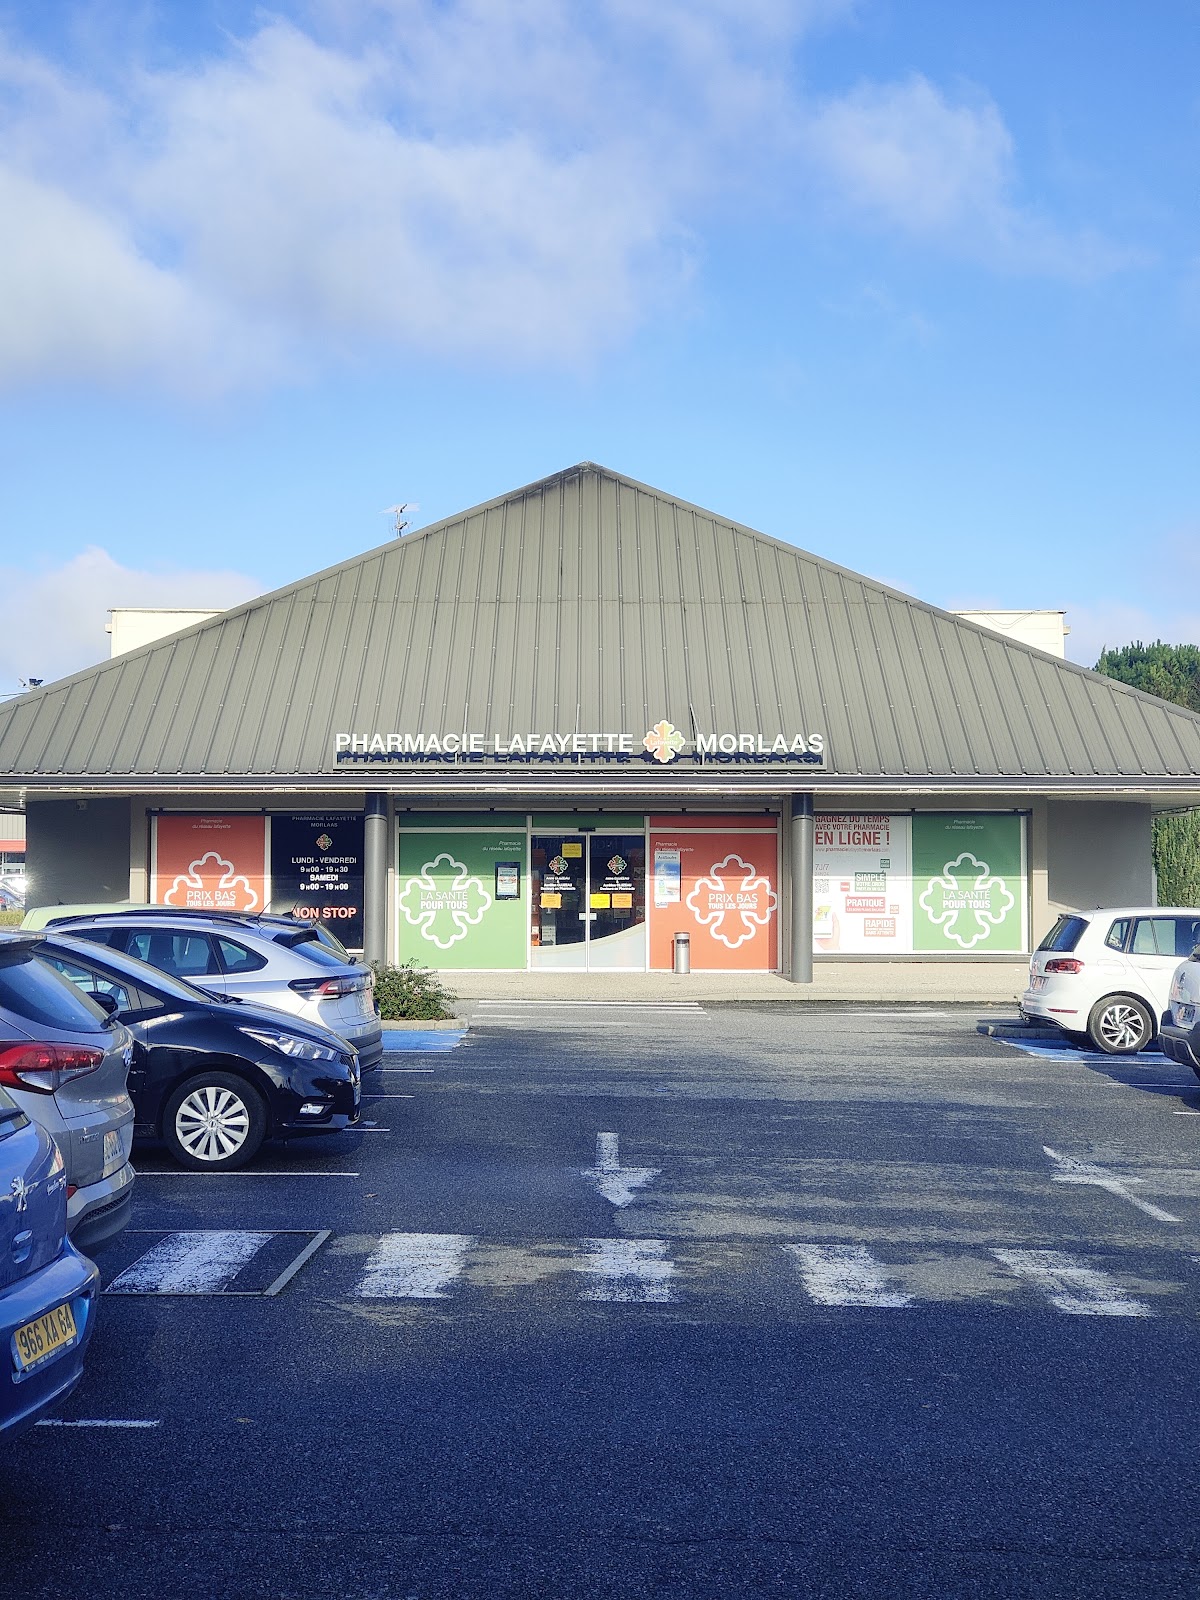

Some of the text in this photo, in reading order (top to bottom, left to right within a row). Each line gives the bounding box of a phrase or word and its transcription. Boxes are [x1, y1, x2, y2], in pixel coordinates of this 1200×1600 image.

[336, 734, 824, 752] PHARMACIE LAFAYETTE MORLAAS
[816, 832, 890, 845] EN LIGNE !
[187, 891, 236, 900] PRIX BAS
[435, 890, 468, 900] SANTÉ
[709, 894, 758, 902] PRIX BAS
[943, 889, 990, 899] LA SANTÉ
[421, 901, 468, 909] POUR TOUS
[292, 907, 356, 918] NON STOP
[19, 1323, 43, 1359] 966
[42, 1315, 59, 1346] XA
[57, 1305, 72, 1336] 64
